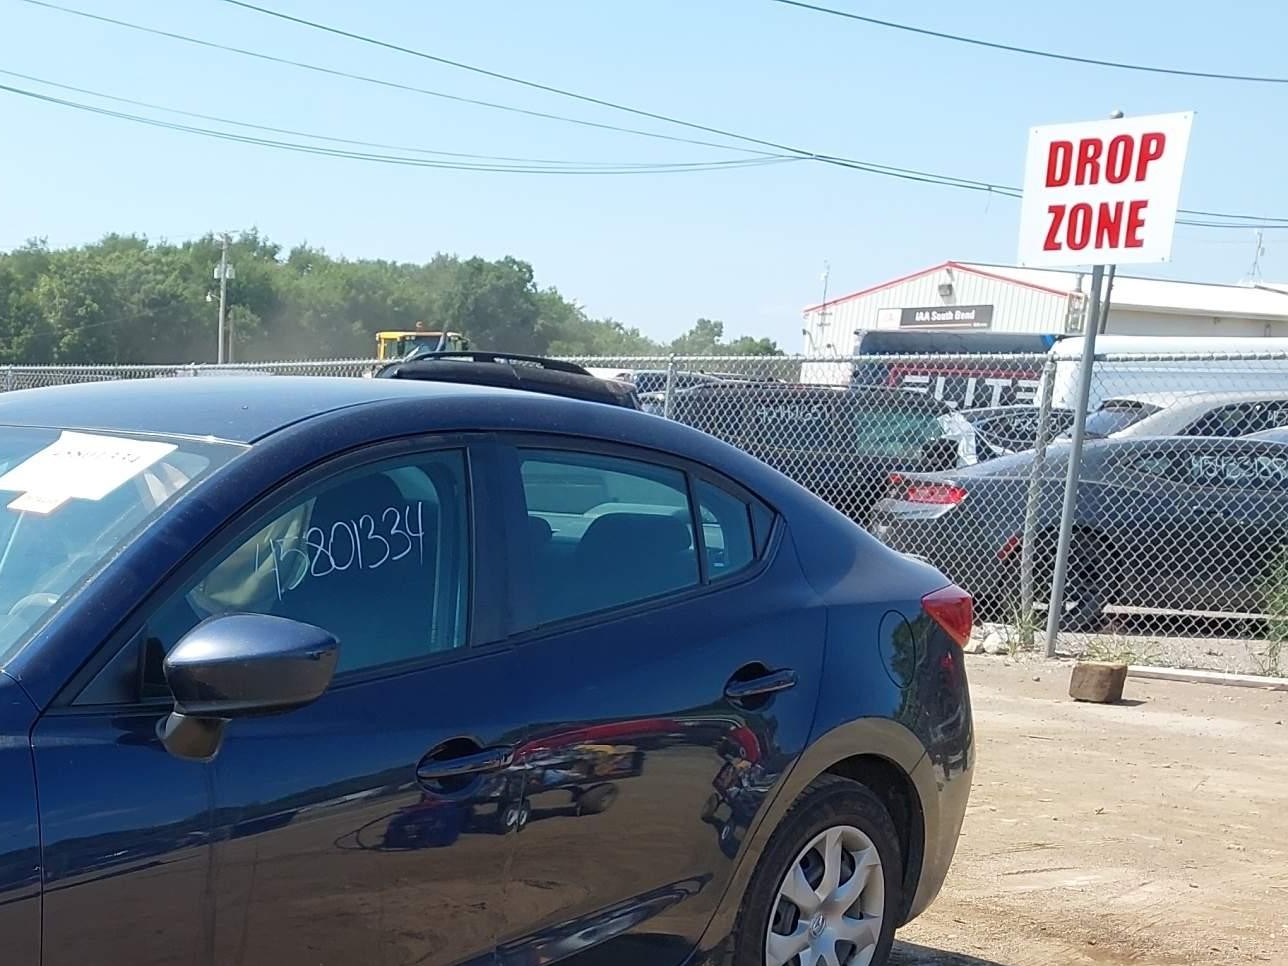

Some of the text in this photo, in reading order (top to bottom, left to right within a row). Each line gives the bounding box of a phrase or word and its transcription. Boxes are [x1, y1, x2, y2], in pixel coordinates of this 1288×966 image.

[1044, 132, 1166, 188] DROP
[1042, 199, 1149, 251] ZONE
[915, 309, 976, 322] IAA South Bend
[254, 501, 425, 601] 45801334
